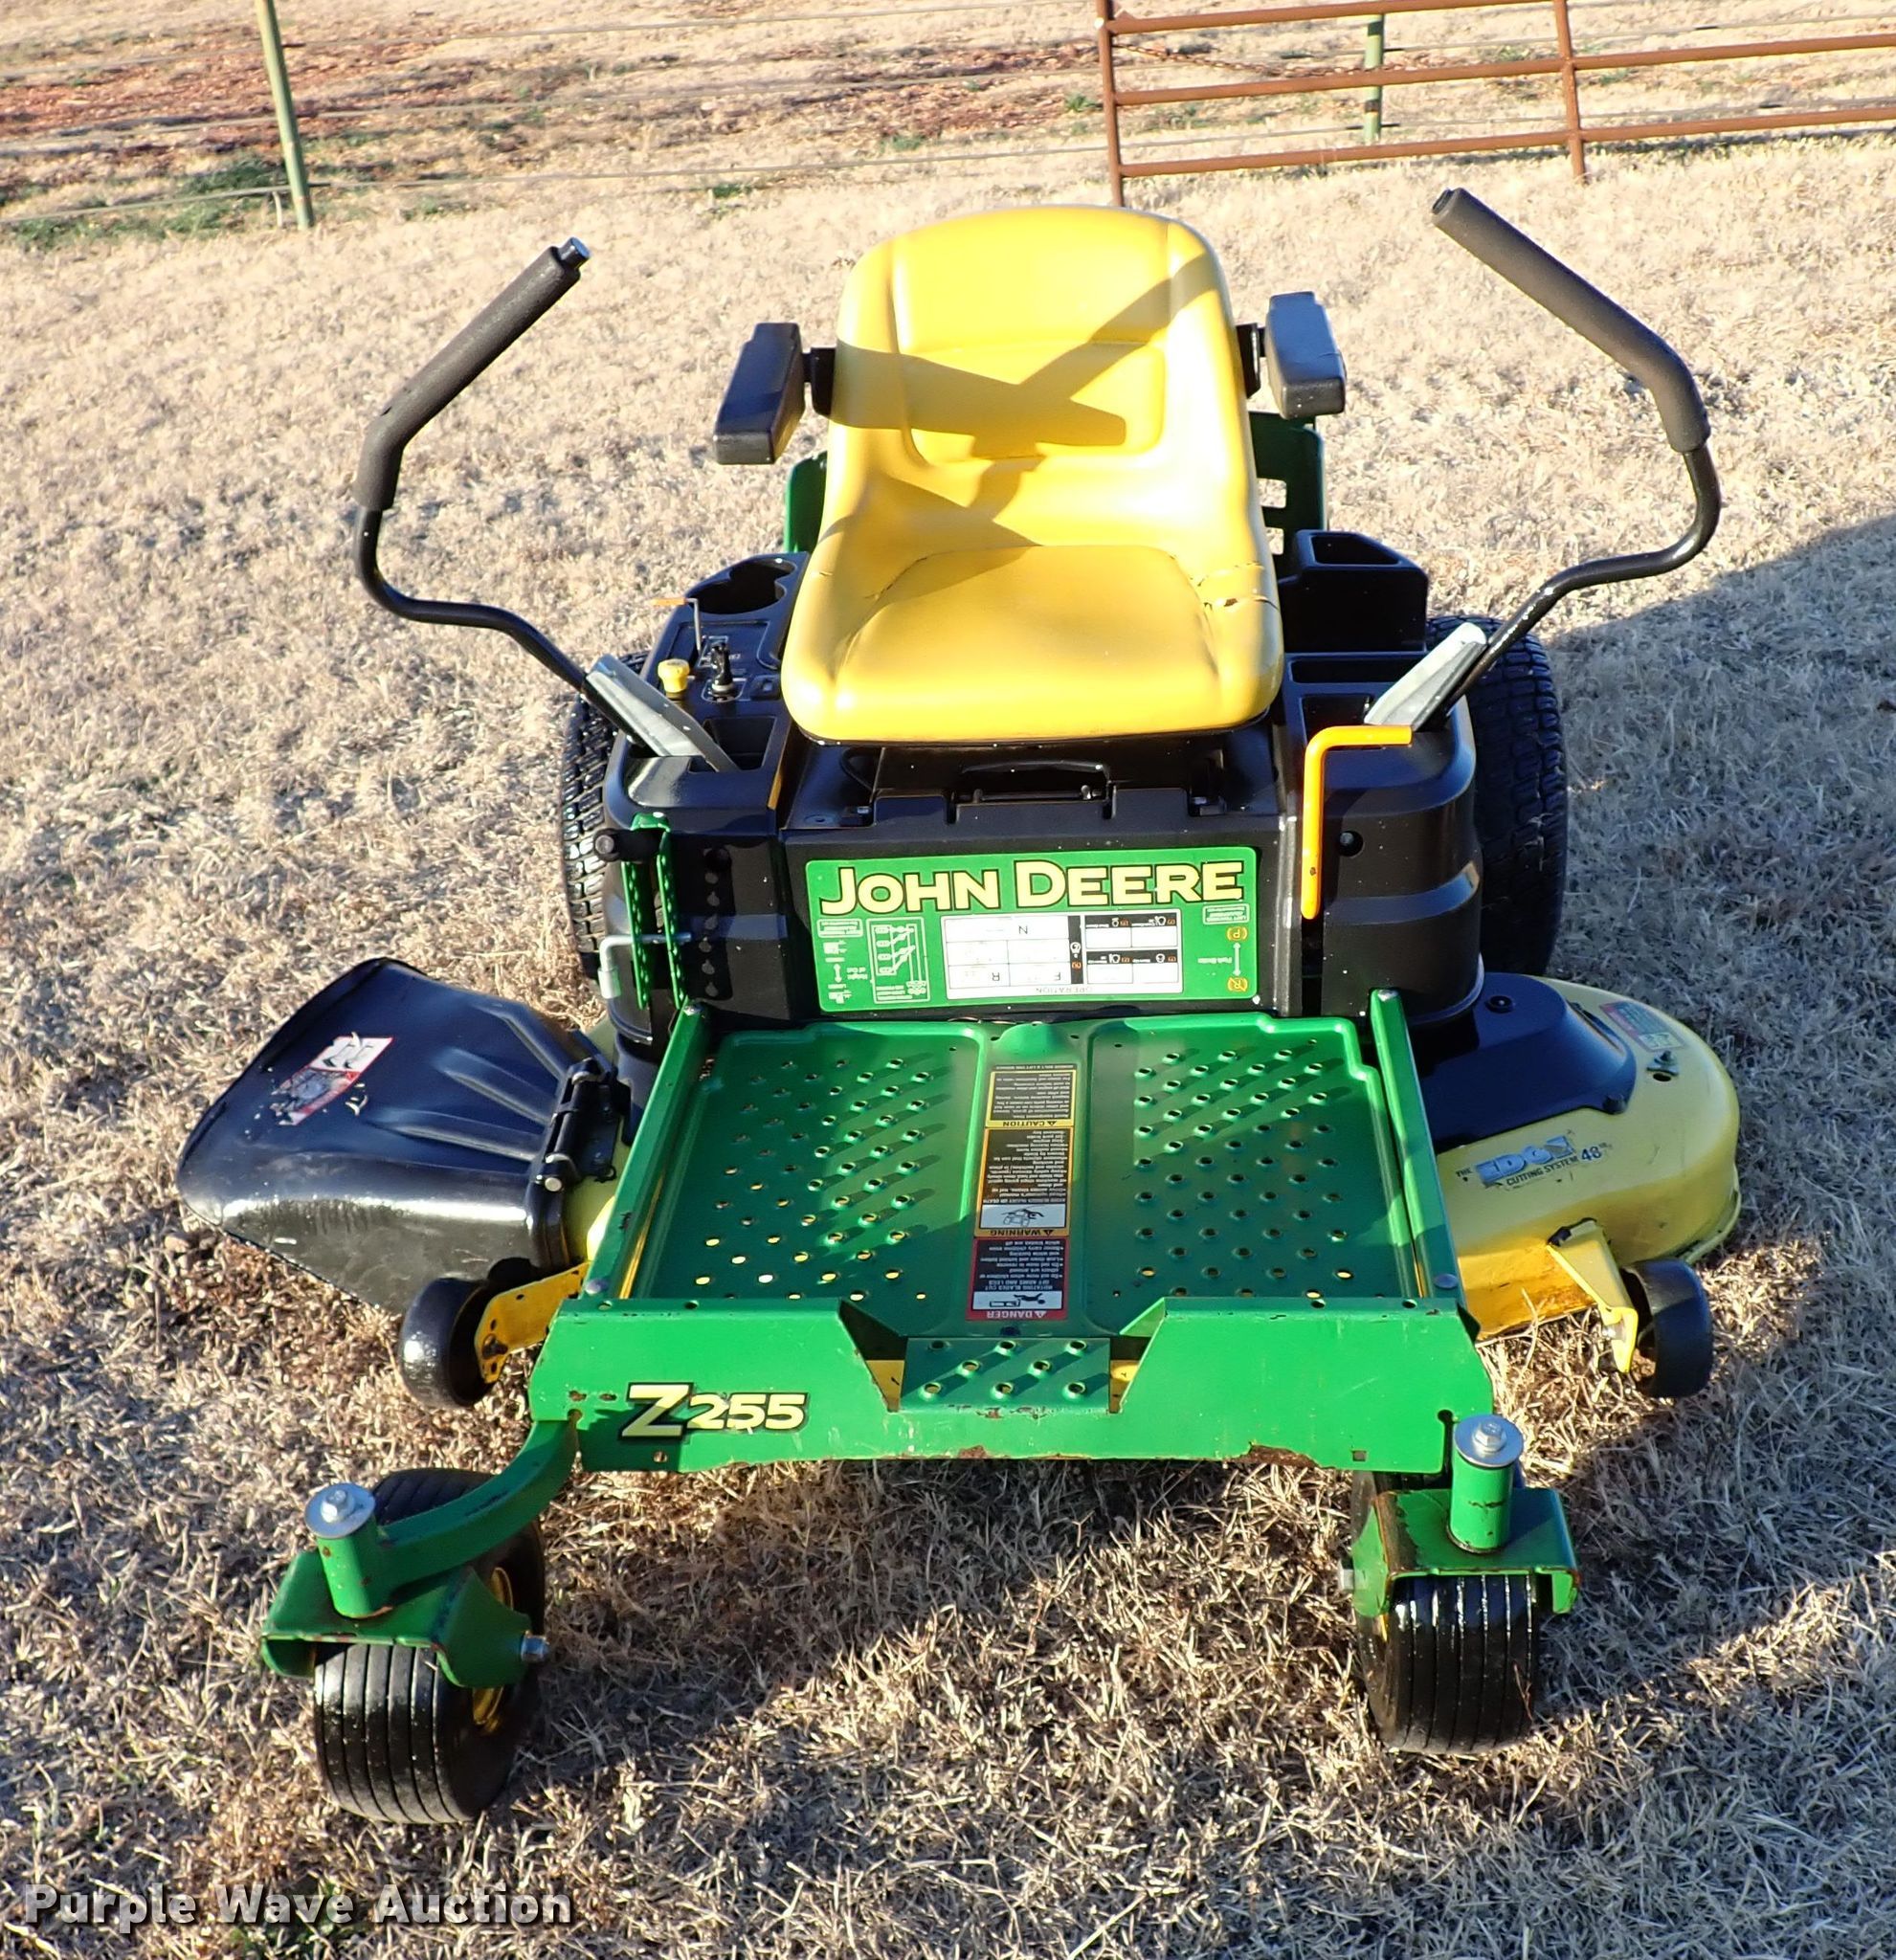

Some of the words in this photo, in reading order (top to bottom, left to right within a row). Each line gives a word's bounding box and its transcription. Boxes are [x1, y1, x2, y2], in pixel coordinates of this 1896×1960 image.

[819, 866, 1000, 916] JOHN
[1013, 860, 1244, 909] DEERE
[1018, 924, 1028, 934] N
[992, 972, 1000, 982] R
[1506, 1164, 1545, 1187] CUTTING
[1544, 1155, 1579, 1173] SYSTEM
[1580, 1145, 1603, 1162] 48
